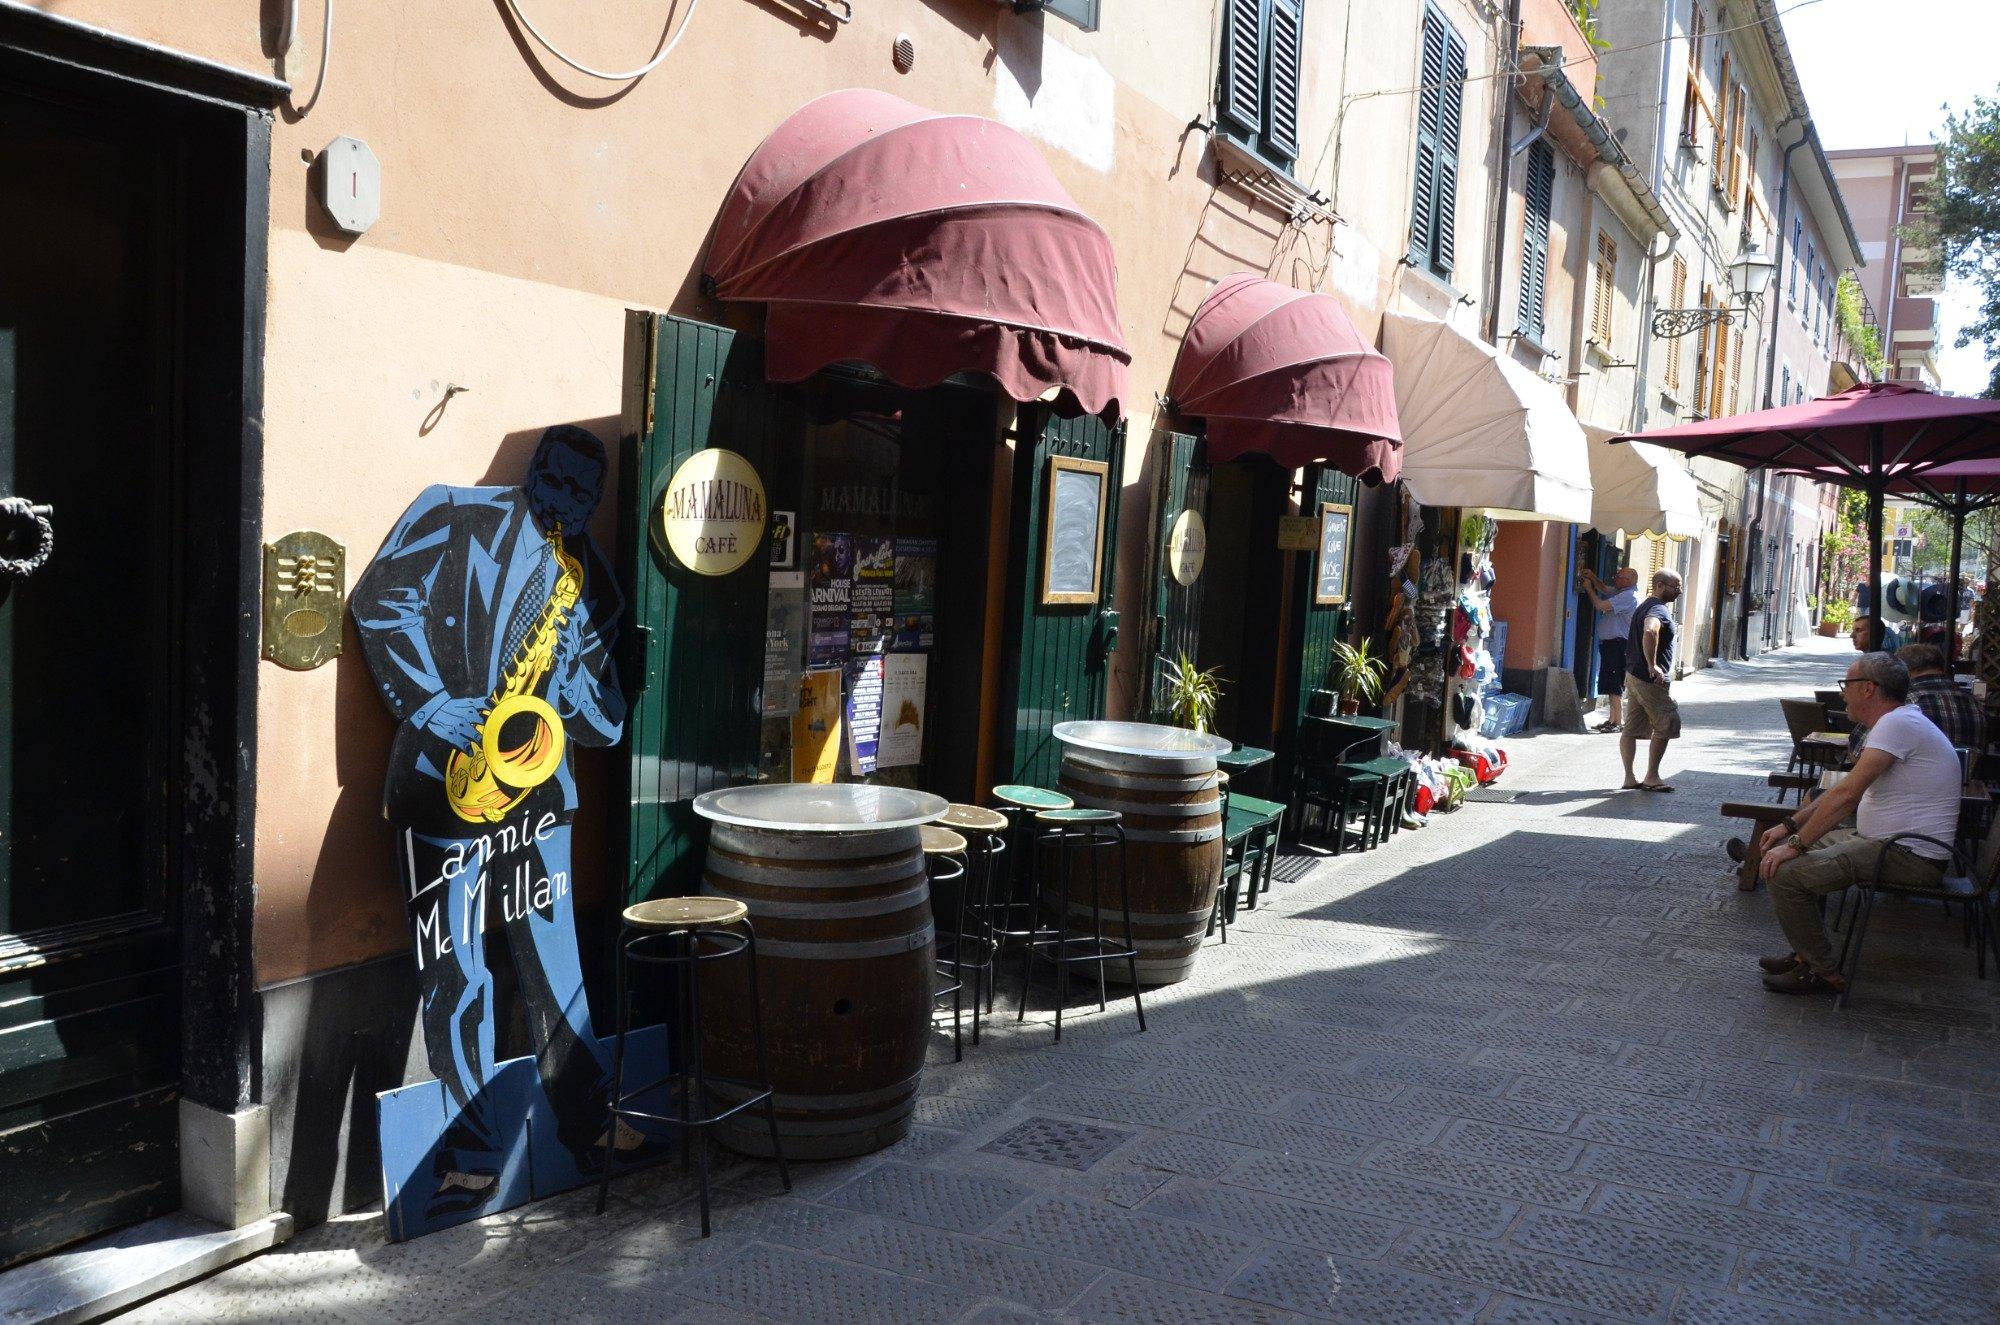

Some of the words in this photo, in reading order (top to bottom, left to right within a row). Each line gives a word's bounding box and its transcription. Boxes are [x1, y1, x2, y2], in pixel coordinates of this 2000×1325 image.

[672, 479, 762, 523] MAMALUNA
[695, 532, 738, 554] CAFÈ
[831, 578, 851, 589] HOUSE
[811, 588, 851, 603] ARNIVAL
[405, 810, 556, 903] Lannie
